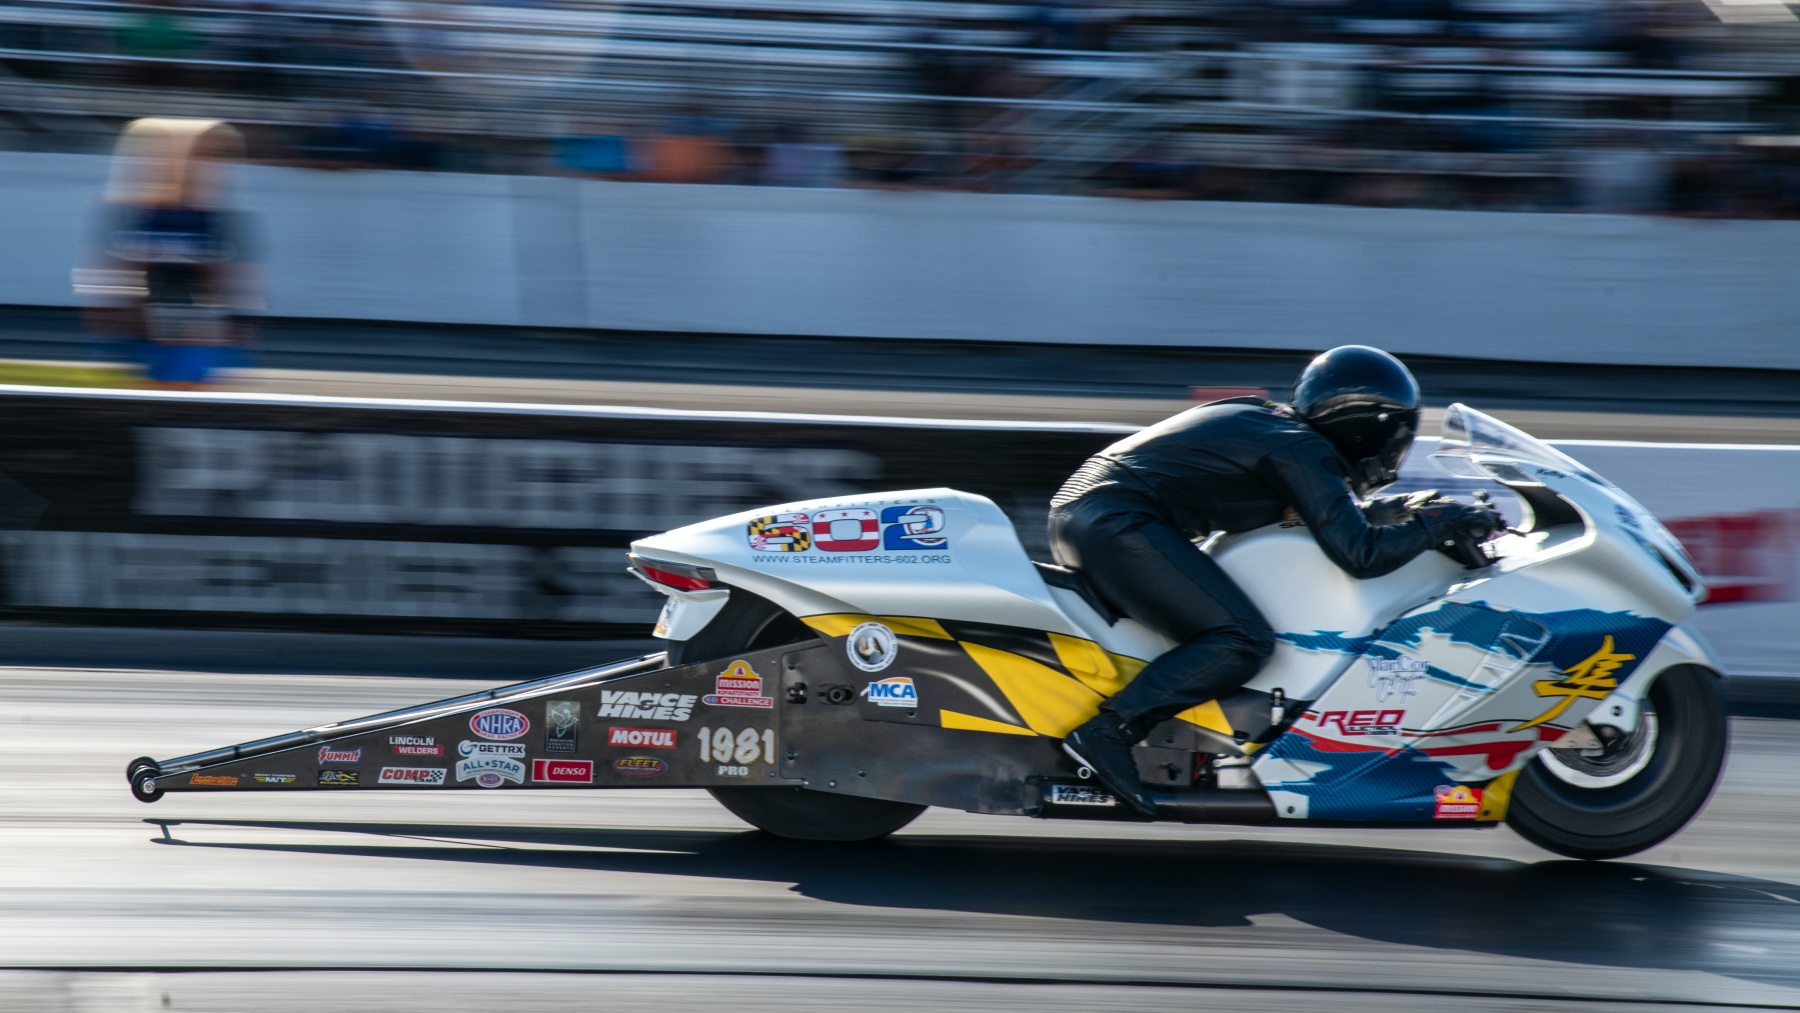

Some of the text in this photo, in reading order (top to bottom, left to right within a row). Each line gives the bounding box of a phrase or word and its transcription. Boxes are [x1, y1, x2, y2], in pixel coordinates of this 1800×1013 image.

[746, 505, 948, 552] 602
[752, 554, 952, 564] WWW.STEAMFITTERS-602.ORG
[870, 683, 915, 698] MCA
[600, 690, 698, 708] VANCE
[721, 697, 771, 706] CHALLENGE
[597, 703, 692, 721] HINES
[480, 714, 521, 734] NHRA
[1318, 709, 1405, 736] RED
[389, 736, 435, 746] LINCOLN
[610, 730, 674, 746] MOTUL
[697, 726, 775, 764] 1981
[318, 746, 361, 765] SUMMIT
[399, 746, 439, 755] WELDERS
[478, 744, 524, 754] GETTRX
[463, 760, 485, 772] ALL
[491, 760, 520, 774] STAR
[619, 759, 660, 768] FLEET
[717, 765, 749, 776] PRO
[381, 768, 430, 781] COMP
[552, 766, 586, 776] DENSO
